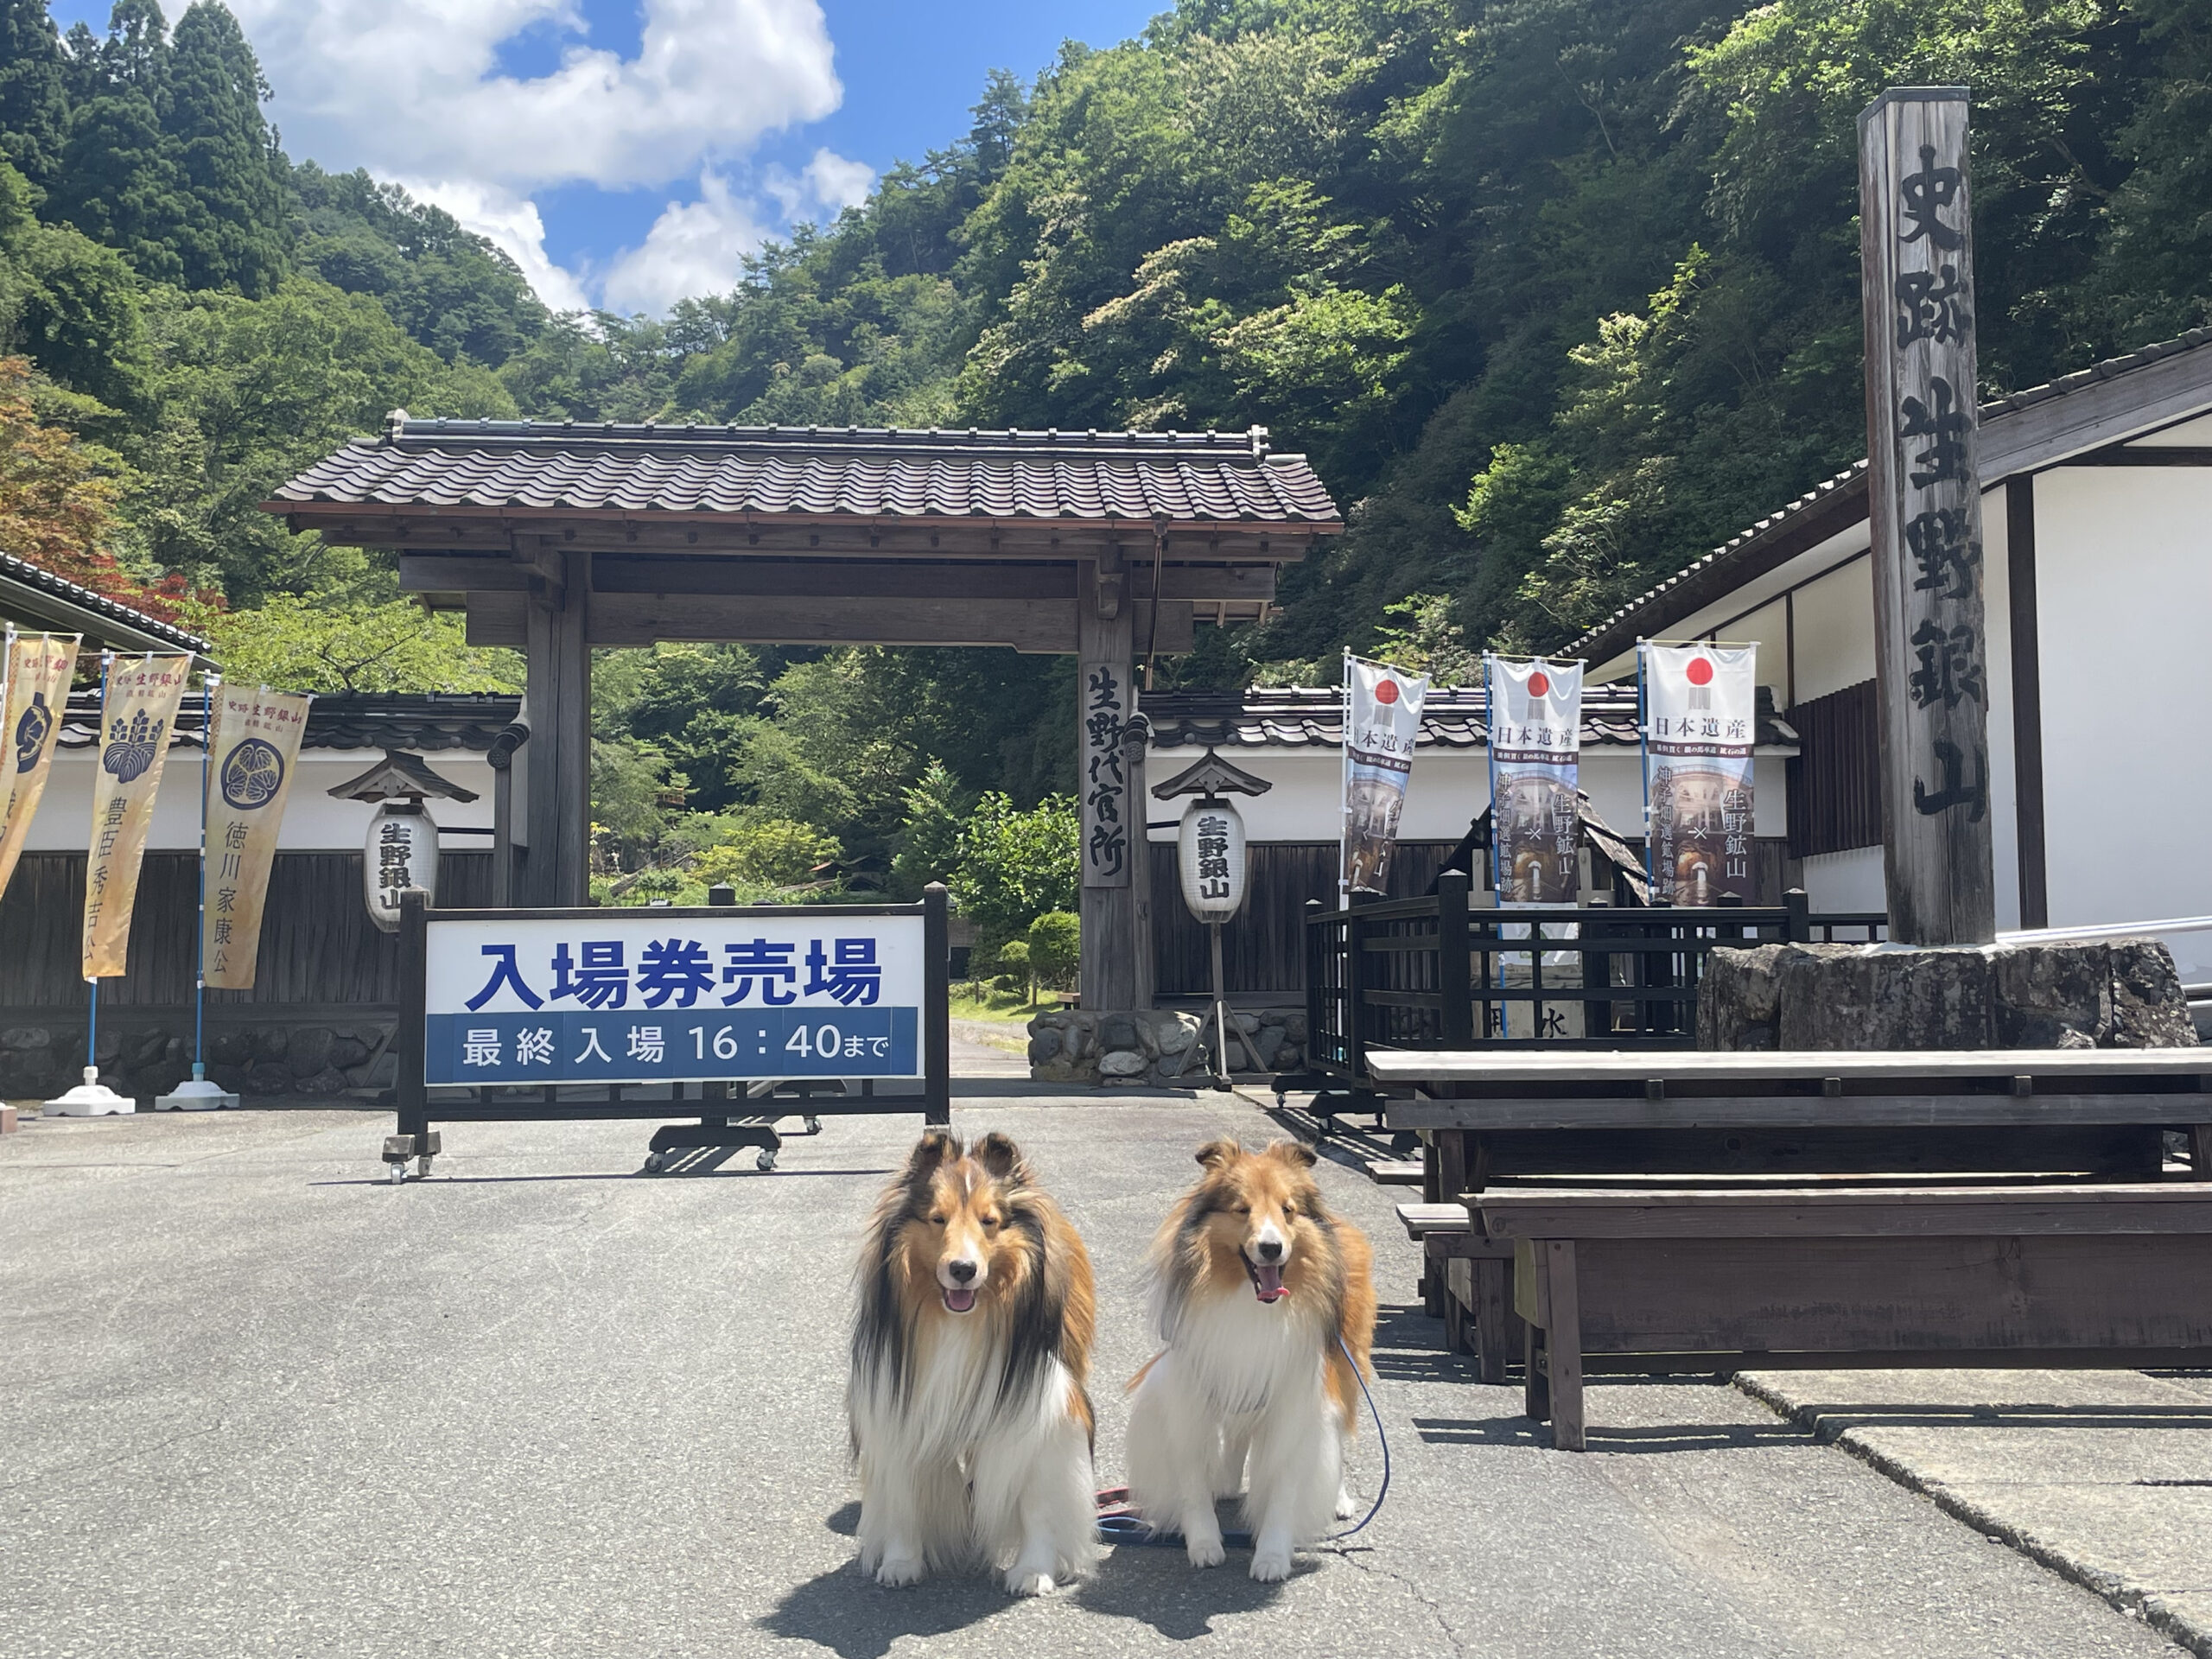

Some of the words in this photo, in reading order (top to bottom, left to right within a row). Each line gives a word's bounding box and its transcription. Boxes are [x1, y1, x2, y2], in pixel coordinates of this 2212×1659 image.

[1895, 143, 1985, 823] 史跡生野銀山
[251, 703, 302, 725] 生野銀山
[1497, 726, 1573, 747] 日本遺産
[1656, 716, 1747, 739] 日本遺産
[1085, 666, 1127, 876] 生野代官所
[378, 823, 412, 911] 生野銀山
[1198, 816, 1230, 899] 生野銀山
[1554, 794, 1575, 876] 生野鉱山
[1723, 790, 1747, 879] 生野鉱山
[84, 796, 127, 960] 豊臣秀吉公
[214, 821, 249, 974] 徳川家康公
[464, 938, 882, 1012] 入場券売場
[462, 1025, 666, 1067] 最終入場
